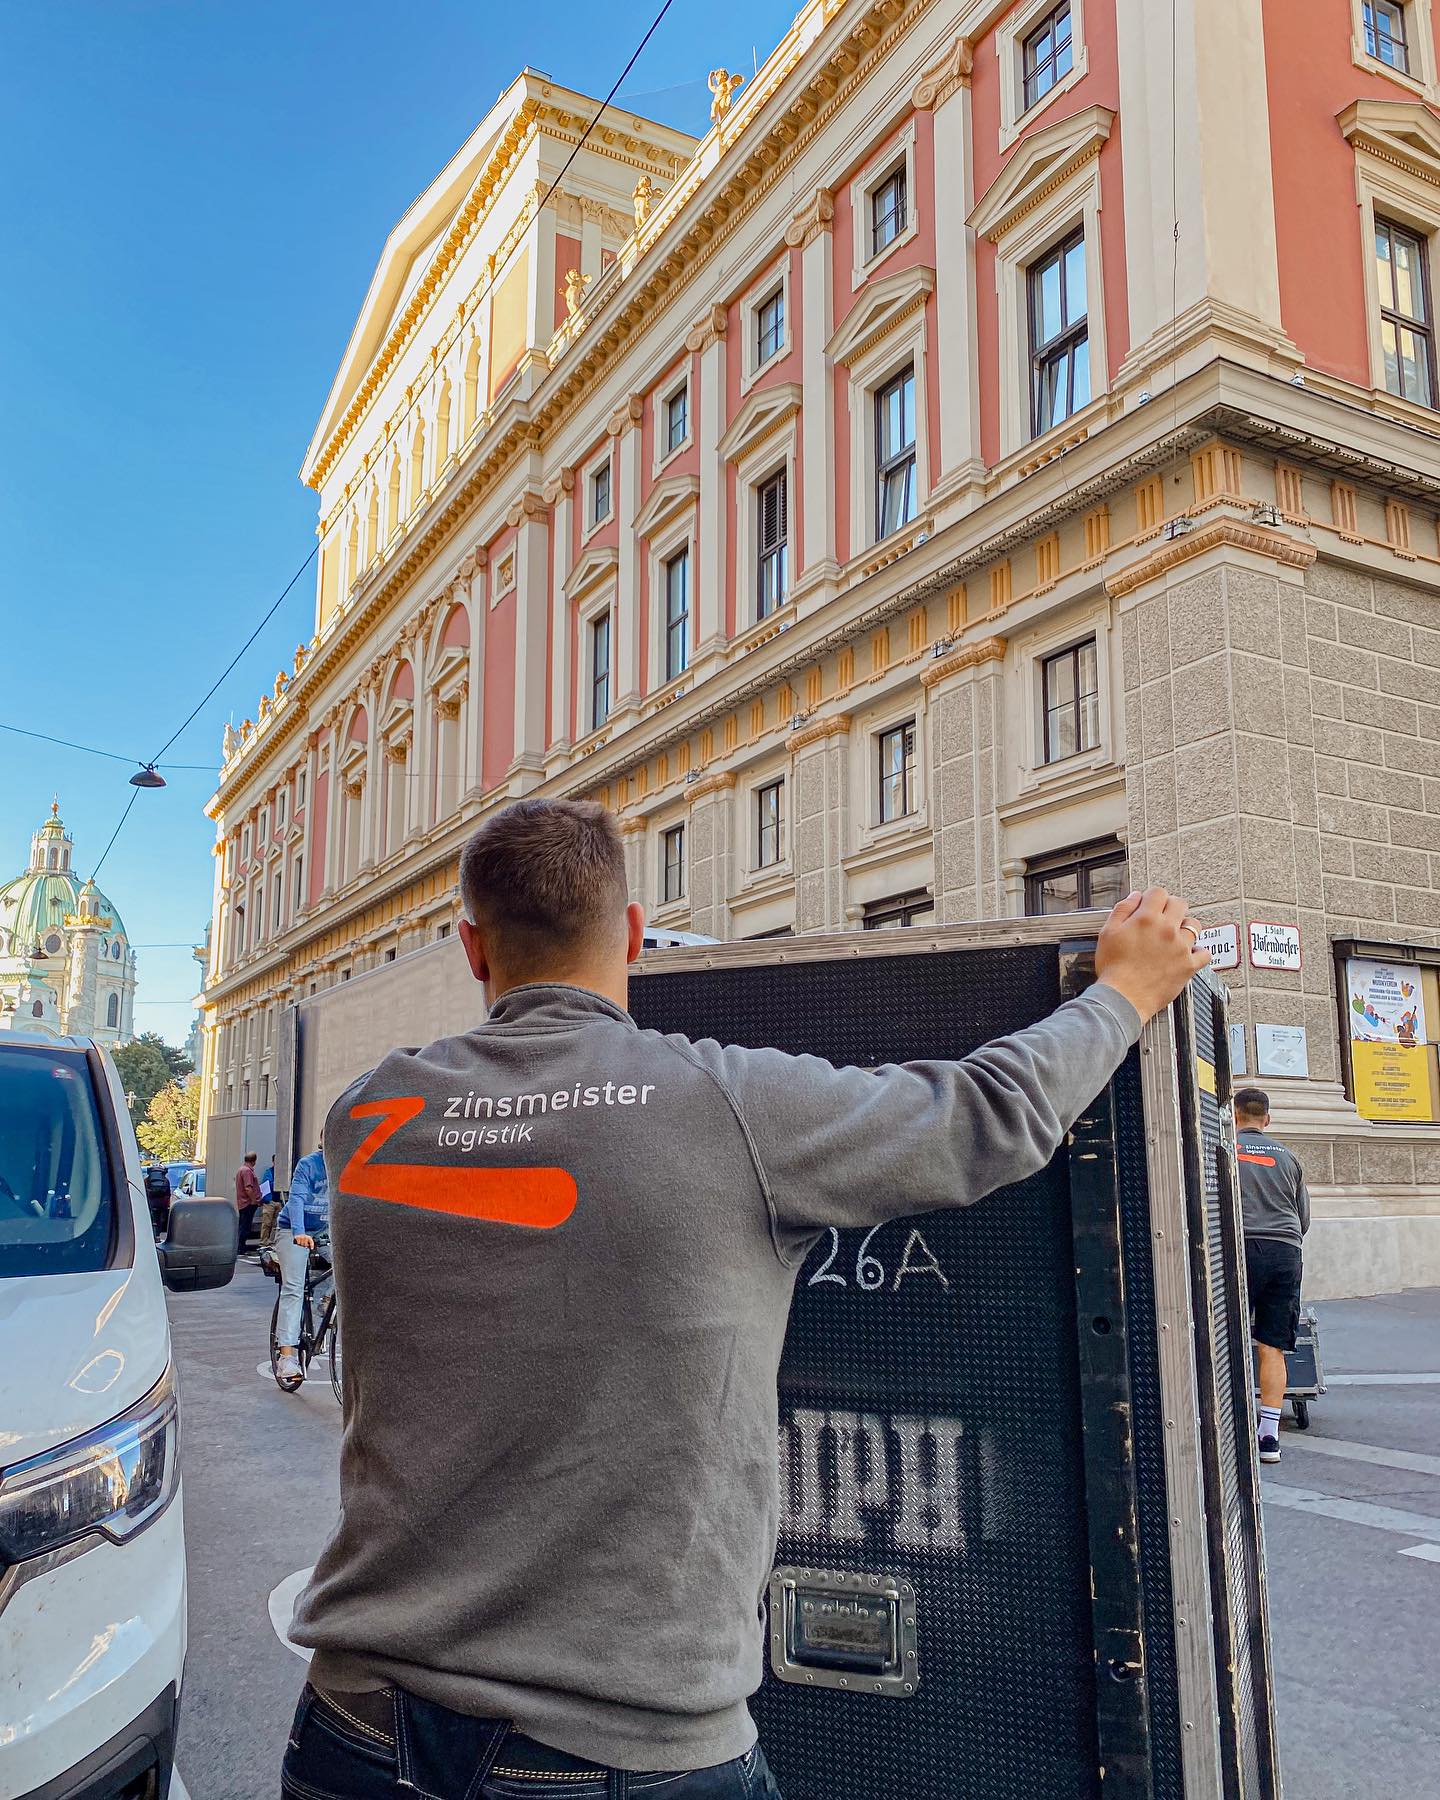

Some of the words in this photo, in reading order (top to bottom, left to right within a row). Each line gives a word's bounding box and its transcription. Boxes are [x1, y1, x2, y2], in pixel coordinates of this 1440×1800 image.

[1208, 958, 1221, 966] sse
[443, 1080, 656, 1118] zinsmeister
[437, 1122, 534, 1152] logistik
